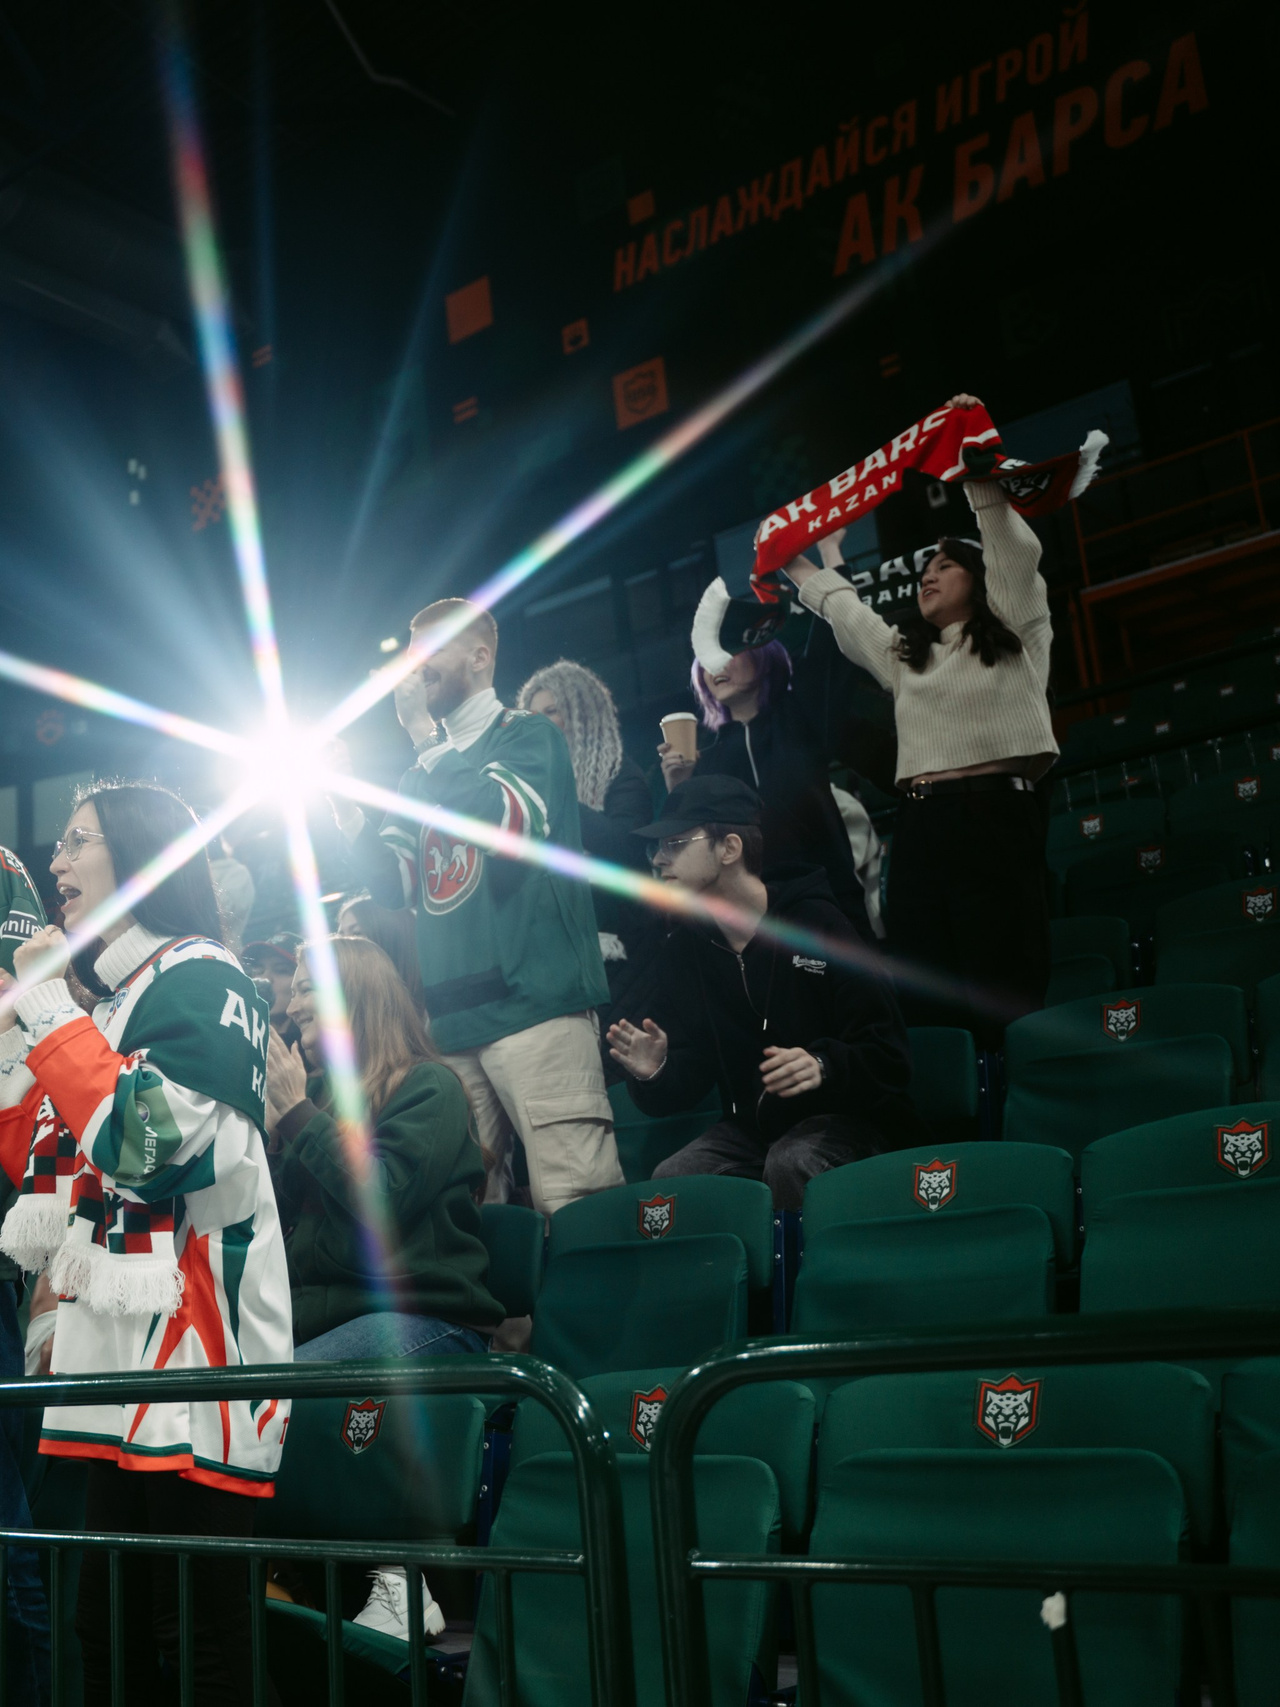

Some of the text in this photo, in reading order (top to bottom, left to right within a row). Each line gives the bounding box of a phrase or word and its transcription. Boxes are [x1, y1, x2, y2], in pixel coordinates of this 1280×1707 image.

[614, 1, 1090, 292] НАСЛАЖДАЙСЯ ИГРОЙ
[832, 31, 1210, 278] АК БАРСА
[758, 490, 818, 544] AK
[807, 469, 898, 534] KAZAN
